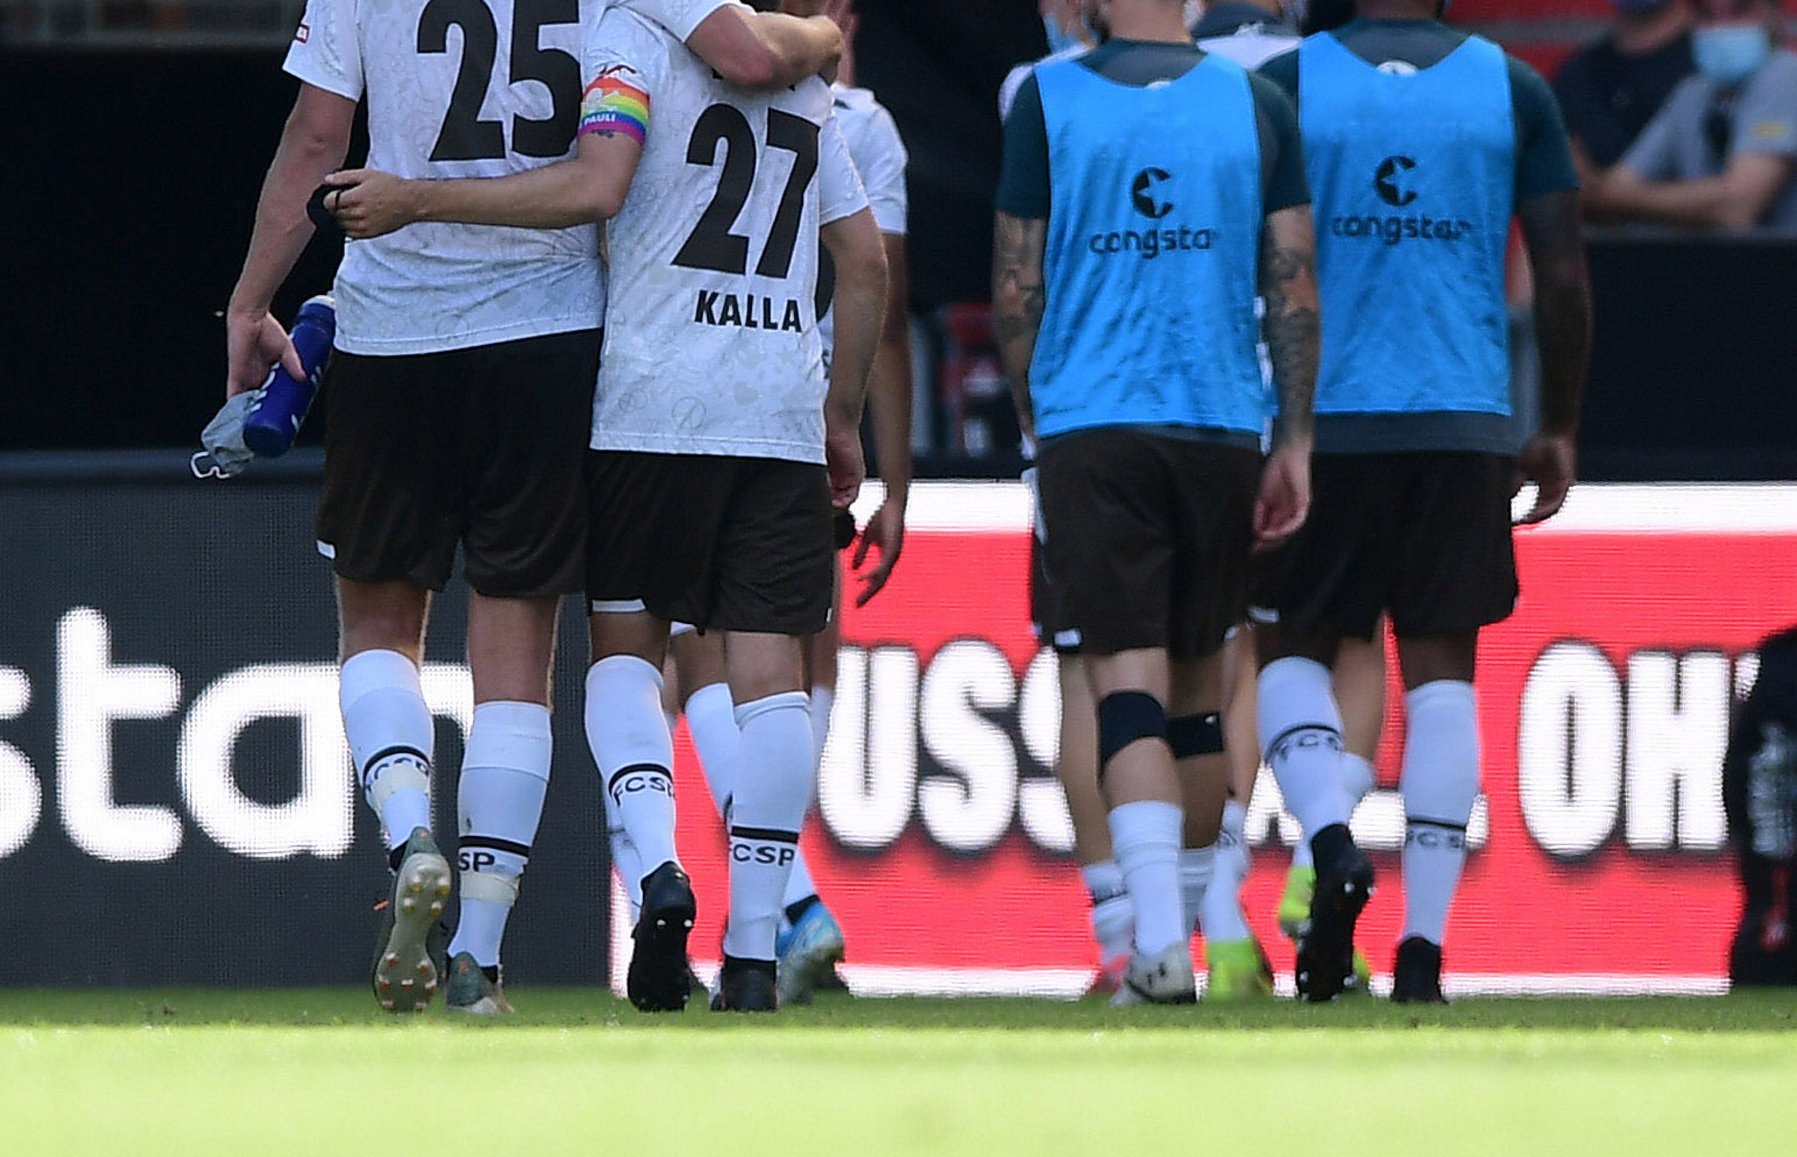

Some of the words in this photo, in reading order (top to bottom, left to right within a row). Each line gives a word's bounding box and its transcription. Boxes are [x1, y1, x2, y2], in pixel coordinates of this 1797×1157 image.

[670, 102, 821, 280] 27
[694, 289, 802, 333] KALLA
[730, 843, 795, 867] CSP
